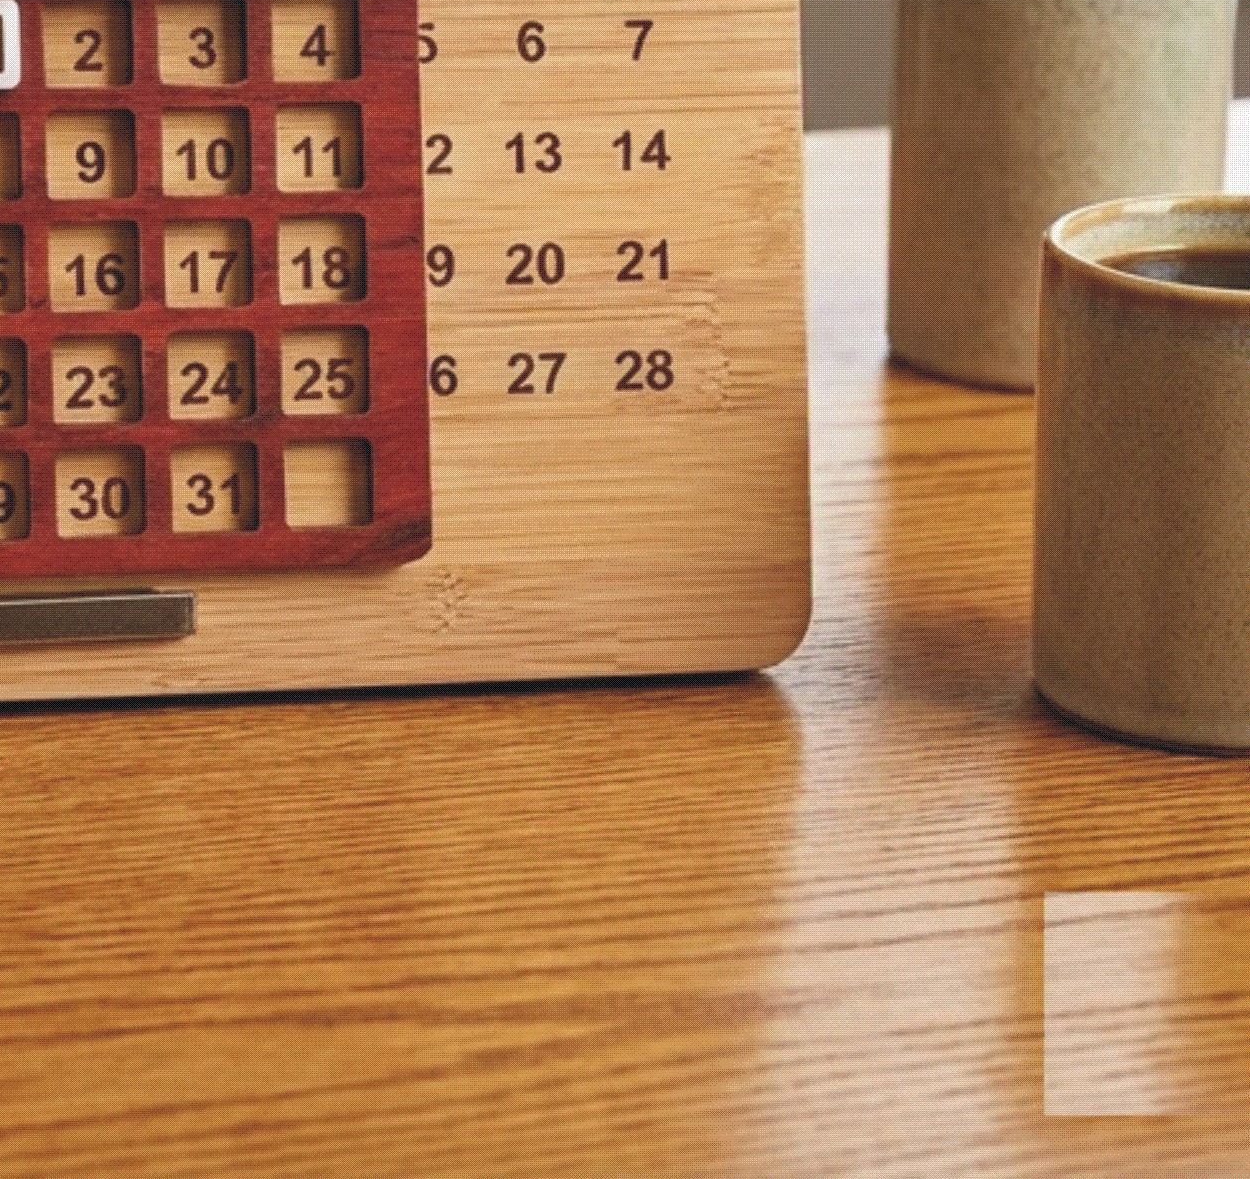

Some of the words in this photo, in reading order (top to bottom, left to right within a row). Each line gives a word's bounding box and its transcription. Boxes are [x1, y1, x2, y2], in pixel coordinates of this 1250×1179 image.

[73, 28, 103, 73] 2
[187, 27, 217, 70] 3
[299, 24, 335, 67] 4
[516, 21, 546, 63] 6
[624, 20, 654, 61] 7
[75, 140, 106, 183] 9
[175, 138, 235, 181] 10
[292, 135, 343, 178] 11
[424, 134, 453, 175] 2
[504, 132, 563, 174] 13
[611, 130, 671, 172] 14
[64, 253, 126, 296] 16
[177, 250, 239, 293] 17
[292, 247, 351, 290] 18
[426, 244, 456, 286] 9
[505, 243, 565, 284] 20
[615, 240, 670, 282] 21
[64, 366, 127, 409] 23
[179, 363, 243, 405] 24
[292, 357, 354, 401] 25
[429, 355, 458, 397] 6
[507, 353, 567, 395] 27
[614, 349, 674, 392] 28
[69, 478, 131, 521] 30
[185, 474, 242, 517] 31
